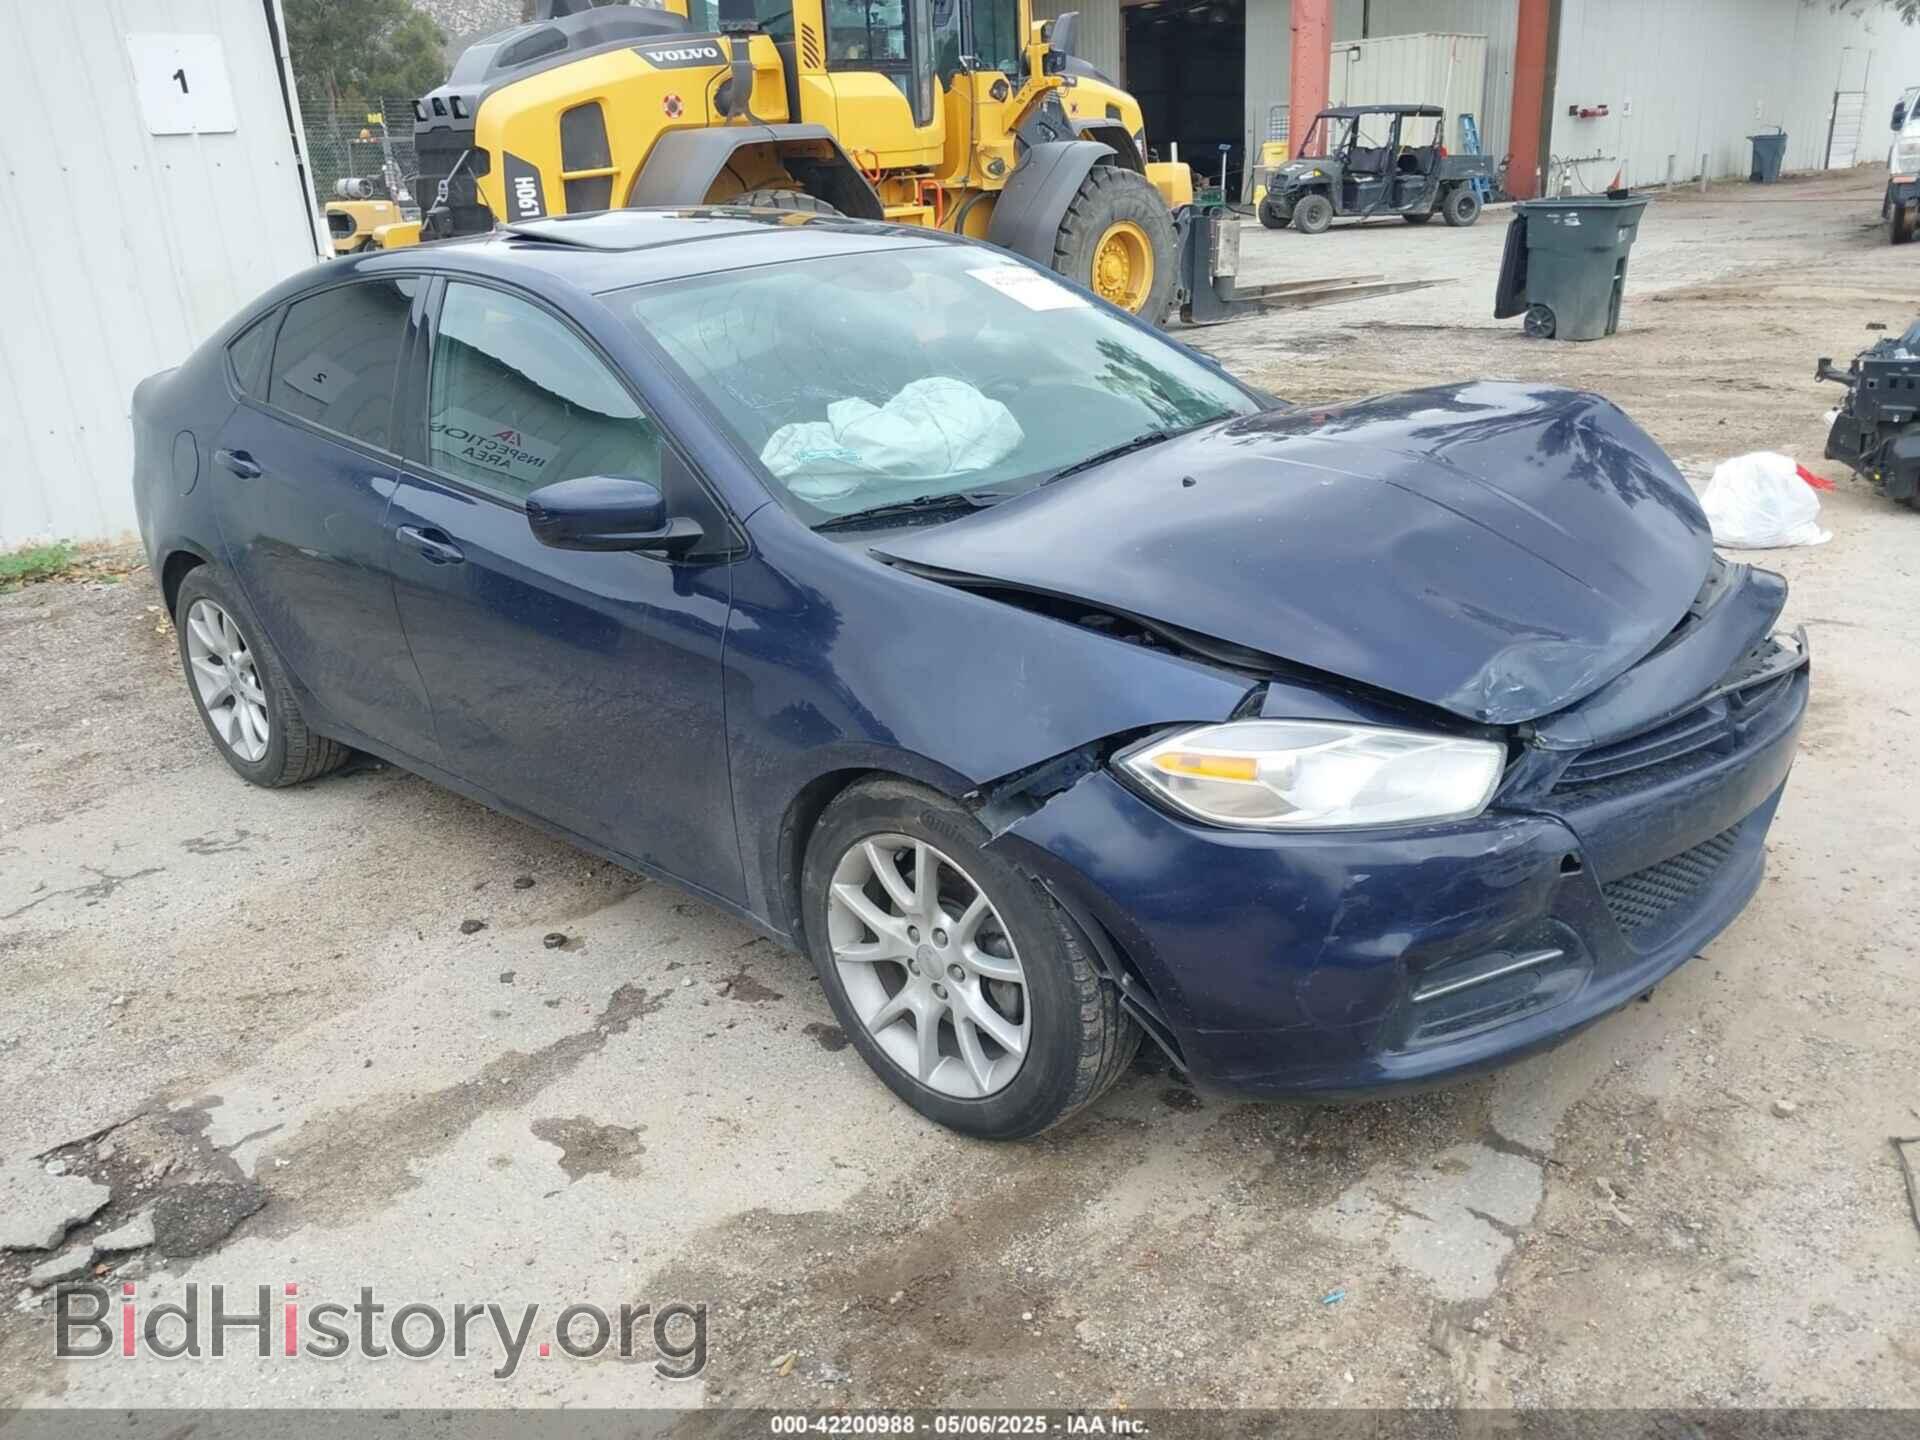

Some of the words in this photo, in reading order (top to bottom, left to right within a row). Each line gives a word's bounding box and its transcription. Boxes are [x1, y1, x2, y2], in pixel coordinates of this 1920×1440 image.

[645, 47, 717, 62] VOLVO
[173, 69, 189, 94] 1
[514, 176, 540, 217] L90H
